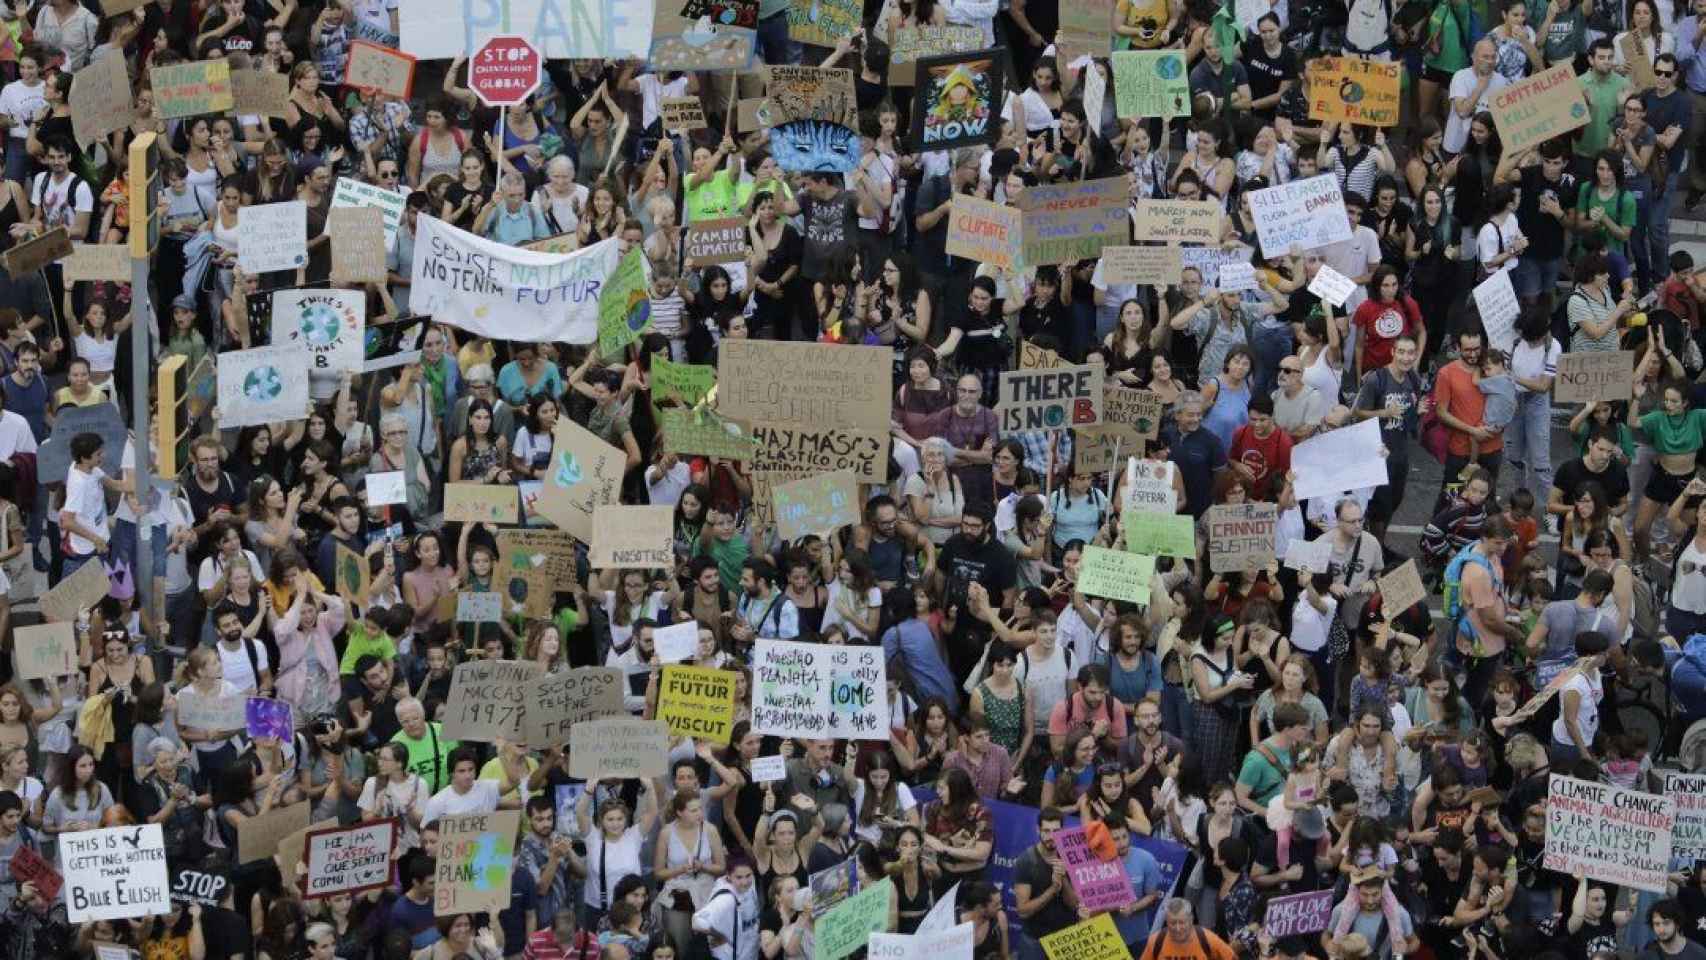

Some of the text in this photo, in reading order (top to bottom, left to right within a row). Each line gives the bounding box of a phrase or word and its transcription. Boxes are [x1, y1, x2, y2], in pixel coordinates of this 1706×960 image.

[484, 47, 530, 61] STOP
[480, 79, 527, 89] GLOBAL
[1495, 69, 1573, 109] CAPITALISM
[923, 118, 988, 143] NOW
[1047, 197, 1099, 211] NEVER
[692, 228, 744, 243] CAMBIO
[515, 279, 601, 306] FUTUR
[315, 354, 330, 369] B
[1008, 371, 1093, 402] THERE
[1561, 370, 1590, 385] NO
[1003, 408, 1022, 432] IS
[1072, 398, 1097, 426] B
[752, 428, 794, 451] HAY
[1213, 520, 1275, 537] CANNOT
[464, 686, 526, 703] MACCAS
[669, 681, 729, 699] FUTUR
[665, 714, 726, 735] VISCUT
[1549, 795, 1596, 817] ANIMAL
[1550, 778, 1606, 804] CLIMATE
[1612, 792, 1669, 814] CHANGE
[439, 816, 488, 834] THERE
[67, 833, 118, 852] THIS IS
[1550, 825, 1651, 856] VEGANISM
[69, 847, 164, 870] GETTING HOTTER
[323, 852, 387, 874] QUE SENTIT
[100, 866, 130, 877] THAN
[116, 879, 162, 906] EILISH
[173, 869, 226, 899] STOP
[1298, 897, 1330, 917] LOVE
[1048, 925, 1096, 950] REDUCE
